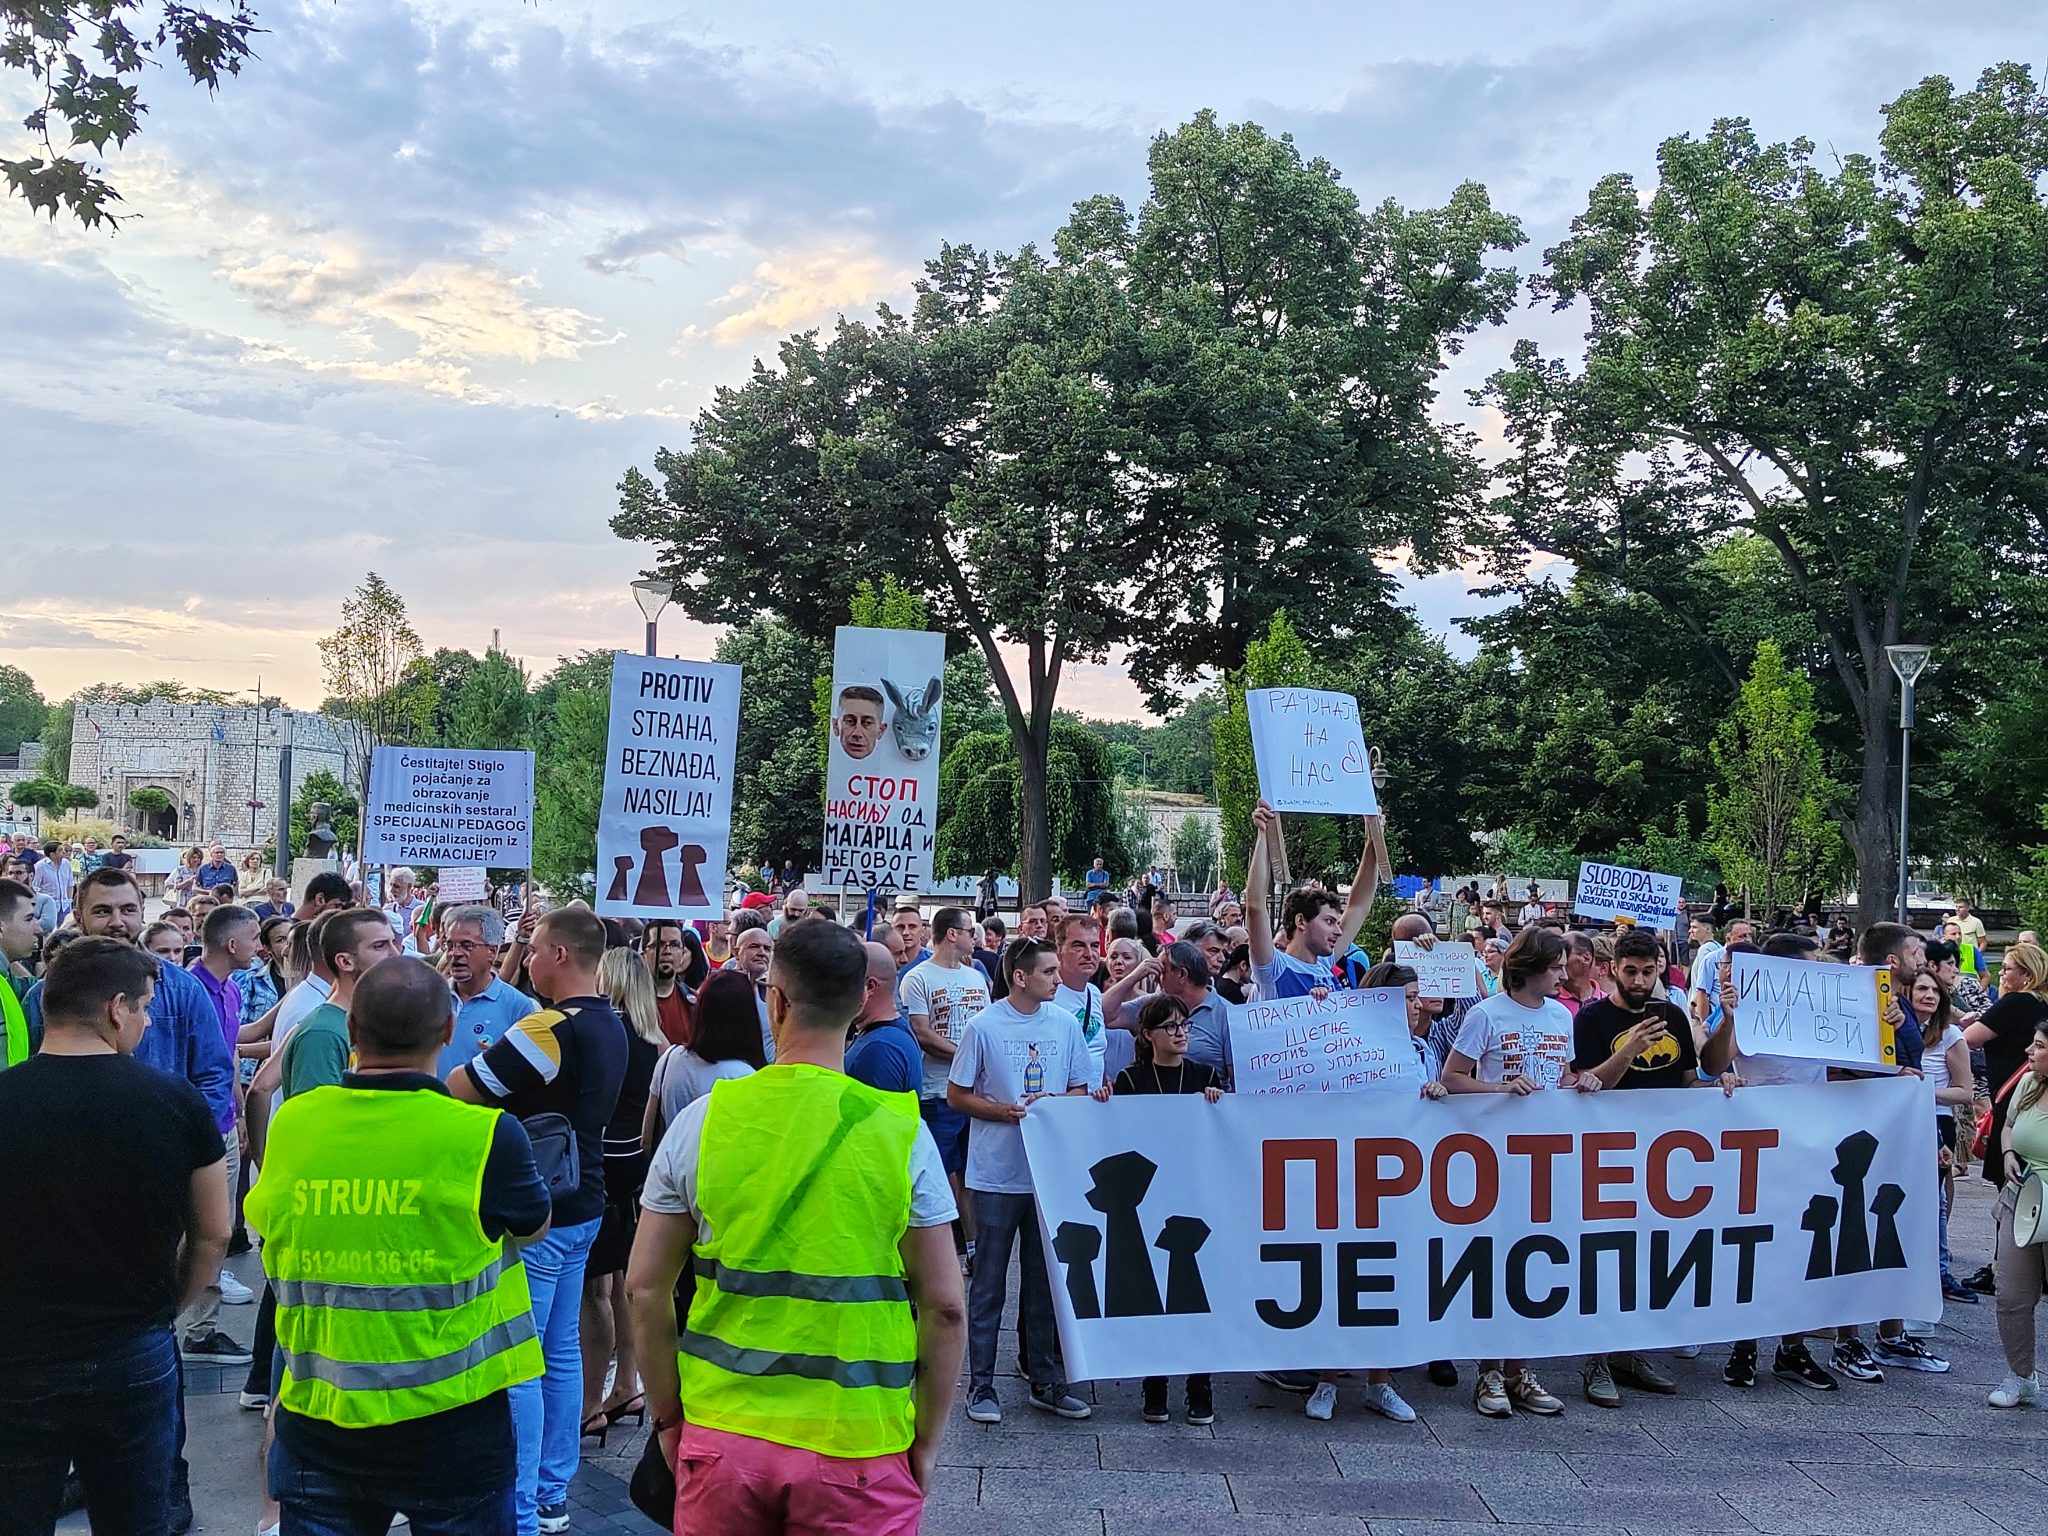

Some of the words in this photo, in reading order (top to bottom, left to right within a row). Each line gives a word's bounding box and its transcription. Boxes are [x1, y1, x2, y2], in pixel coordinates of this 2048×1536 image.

[640, 671, 714, 703] PROTIV
[632, 710, 718, 745] STRAHA,
[1304, 722, 1328, 748] НА
[400, 754, 464, 771] Čestitajte!
[467, 759, 505, 773] Stiglo
[621, 748, 721, 784] BEZNAĐA,
[1291, 754, 1335, 787] НАС
[412, 772, 473, 787] pojačanje
[477, 776, 491, 786] za
[848, 774, 918, 802] СТОП
[384, 802, 461, 815] medicinskih
[465, 805, 517, 816] sestara!
[412, 788, 490, 803] obrazovanje
[623, 787, 712, 818] NASILJA!
[373, 815, 453, 829] SPECIJALNI
[457, 818, 526, 831] PEDAGOG
[827, 800, 891, 824] НАСИЉУ
[901, 807, 927, 828] ОД
[380, 833, 396, 842] sa
[400, 832, 503, 848] specijalizacijom
[507, 835, 518, 846] iz
[825, 823, 912, 851] МАГАРЦА
[923, 835, 933, 851] И
[400, 847, 497, 861] FARMACIJE!?
[825, 849, 918, 872] ЊЕГОВОГ
[829, 868, 920, 891] ГАЗДЕ
[1577, 894, 1615, 909] NESKLADA
[1621, 891, 1627, 899] O
[1629, 892, 1668, 906] SKLADU
[1741, 968, 1858, 1019] ИМАТЕ
[1285, 1022, 1350, 1047] ШЕТЊЕ
[1753, 1007, 1793, 1041] ЛИ
[1814, 1015, 1865, 1054] ВИ
[1250, 1047, 1309, 1071] ПРОТИВ
[1324, 1036, 1363, 1054] ОНИХ
[1278, 1063, 1315, 1081] ШТО
[1262, 1129, 1780, 1231] ПРОТЕСТ
[294, 1178, 422, 1216] STRUNZ
[1254, 1241, 1400, 1330] ЈЕ
[1427, 1224, 1774, 1323] ИСПИТ
